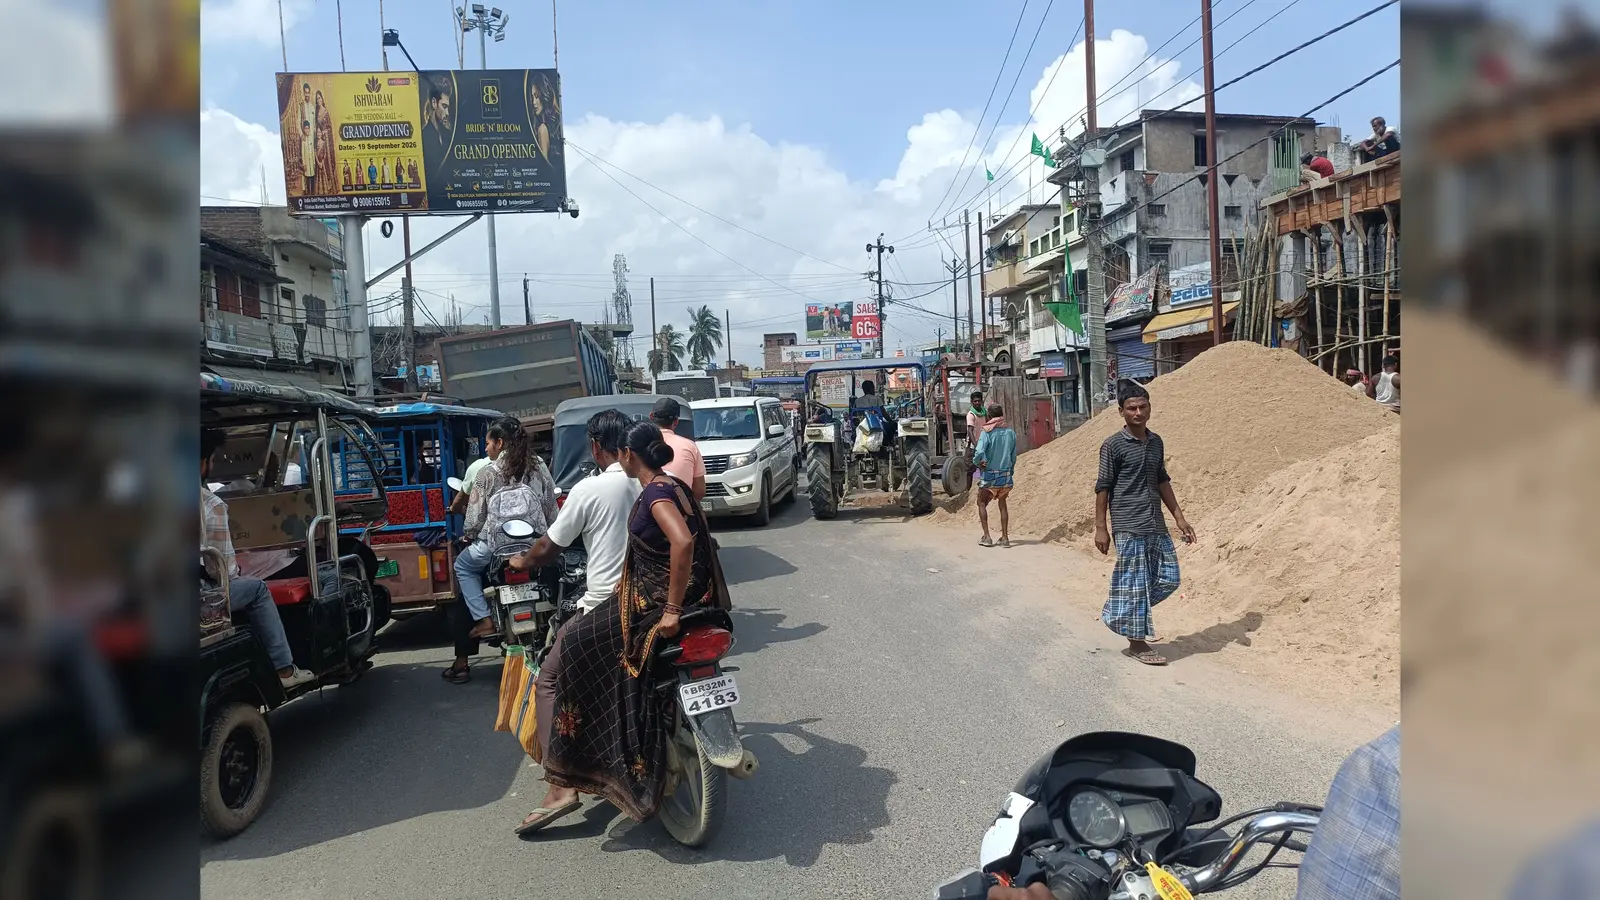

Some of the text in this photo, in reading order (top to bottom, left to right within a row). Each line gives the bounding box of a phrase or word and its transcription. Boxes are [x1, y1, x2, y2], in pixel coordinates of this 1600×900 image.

[353, 94, 393, 107] ISHWARAM
[384, 112, 397, 120] MALL
[342, 123, 410, 139] GRAND OPENING
[465, 124, 486, 133] BRIDE
[496, 123, 521, 132] BLOOM
[367, 142, 400, 151] September
[401, 141, 417, 149] 2026
[454, 143, 536, 160] GRAND OPENING
[359, 196, 391, 207] 9006155015
[856, 303, 877, 314] SALE
[233, 382, 273, 394] MAYURI
[690, 679, 727, 695] BR32M
[688, 691, 738, 712] 4183
